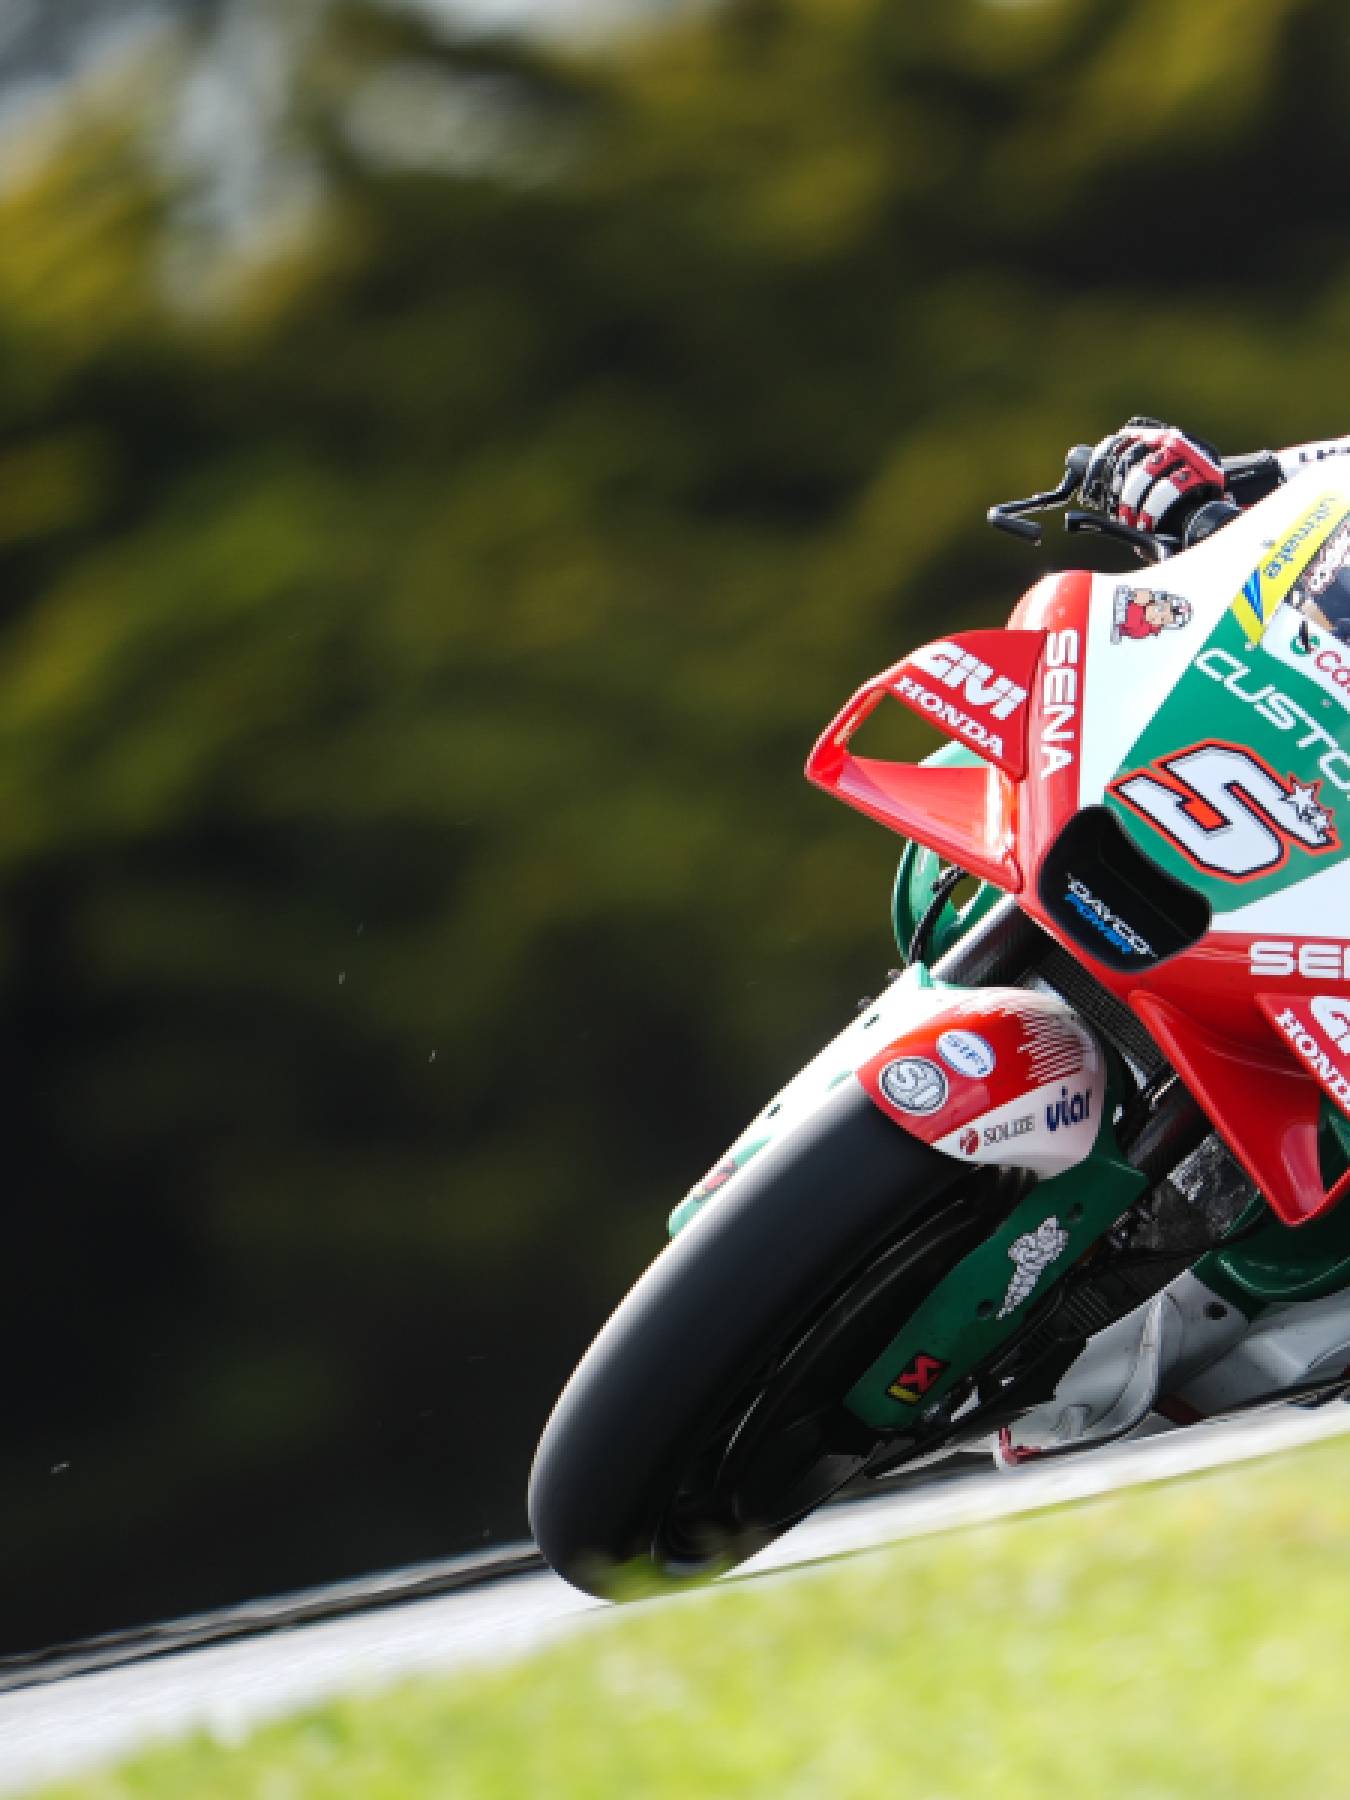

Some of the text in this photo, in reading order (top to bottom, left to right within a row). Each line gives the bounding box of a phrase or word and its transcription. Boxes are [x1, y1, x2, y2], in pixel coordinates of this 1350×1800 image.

[893, 675, 1004, 759] HONDA
[909, 642, 1029, 720] GIVI
[1041, 628, 1080, 780] SENA
[1106, 739, 1341, 883] 5
